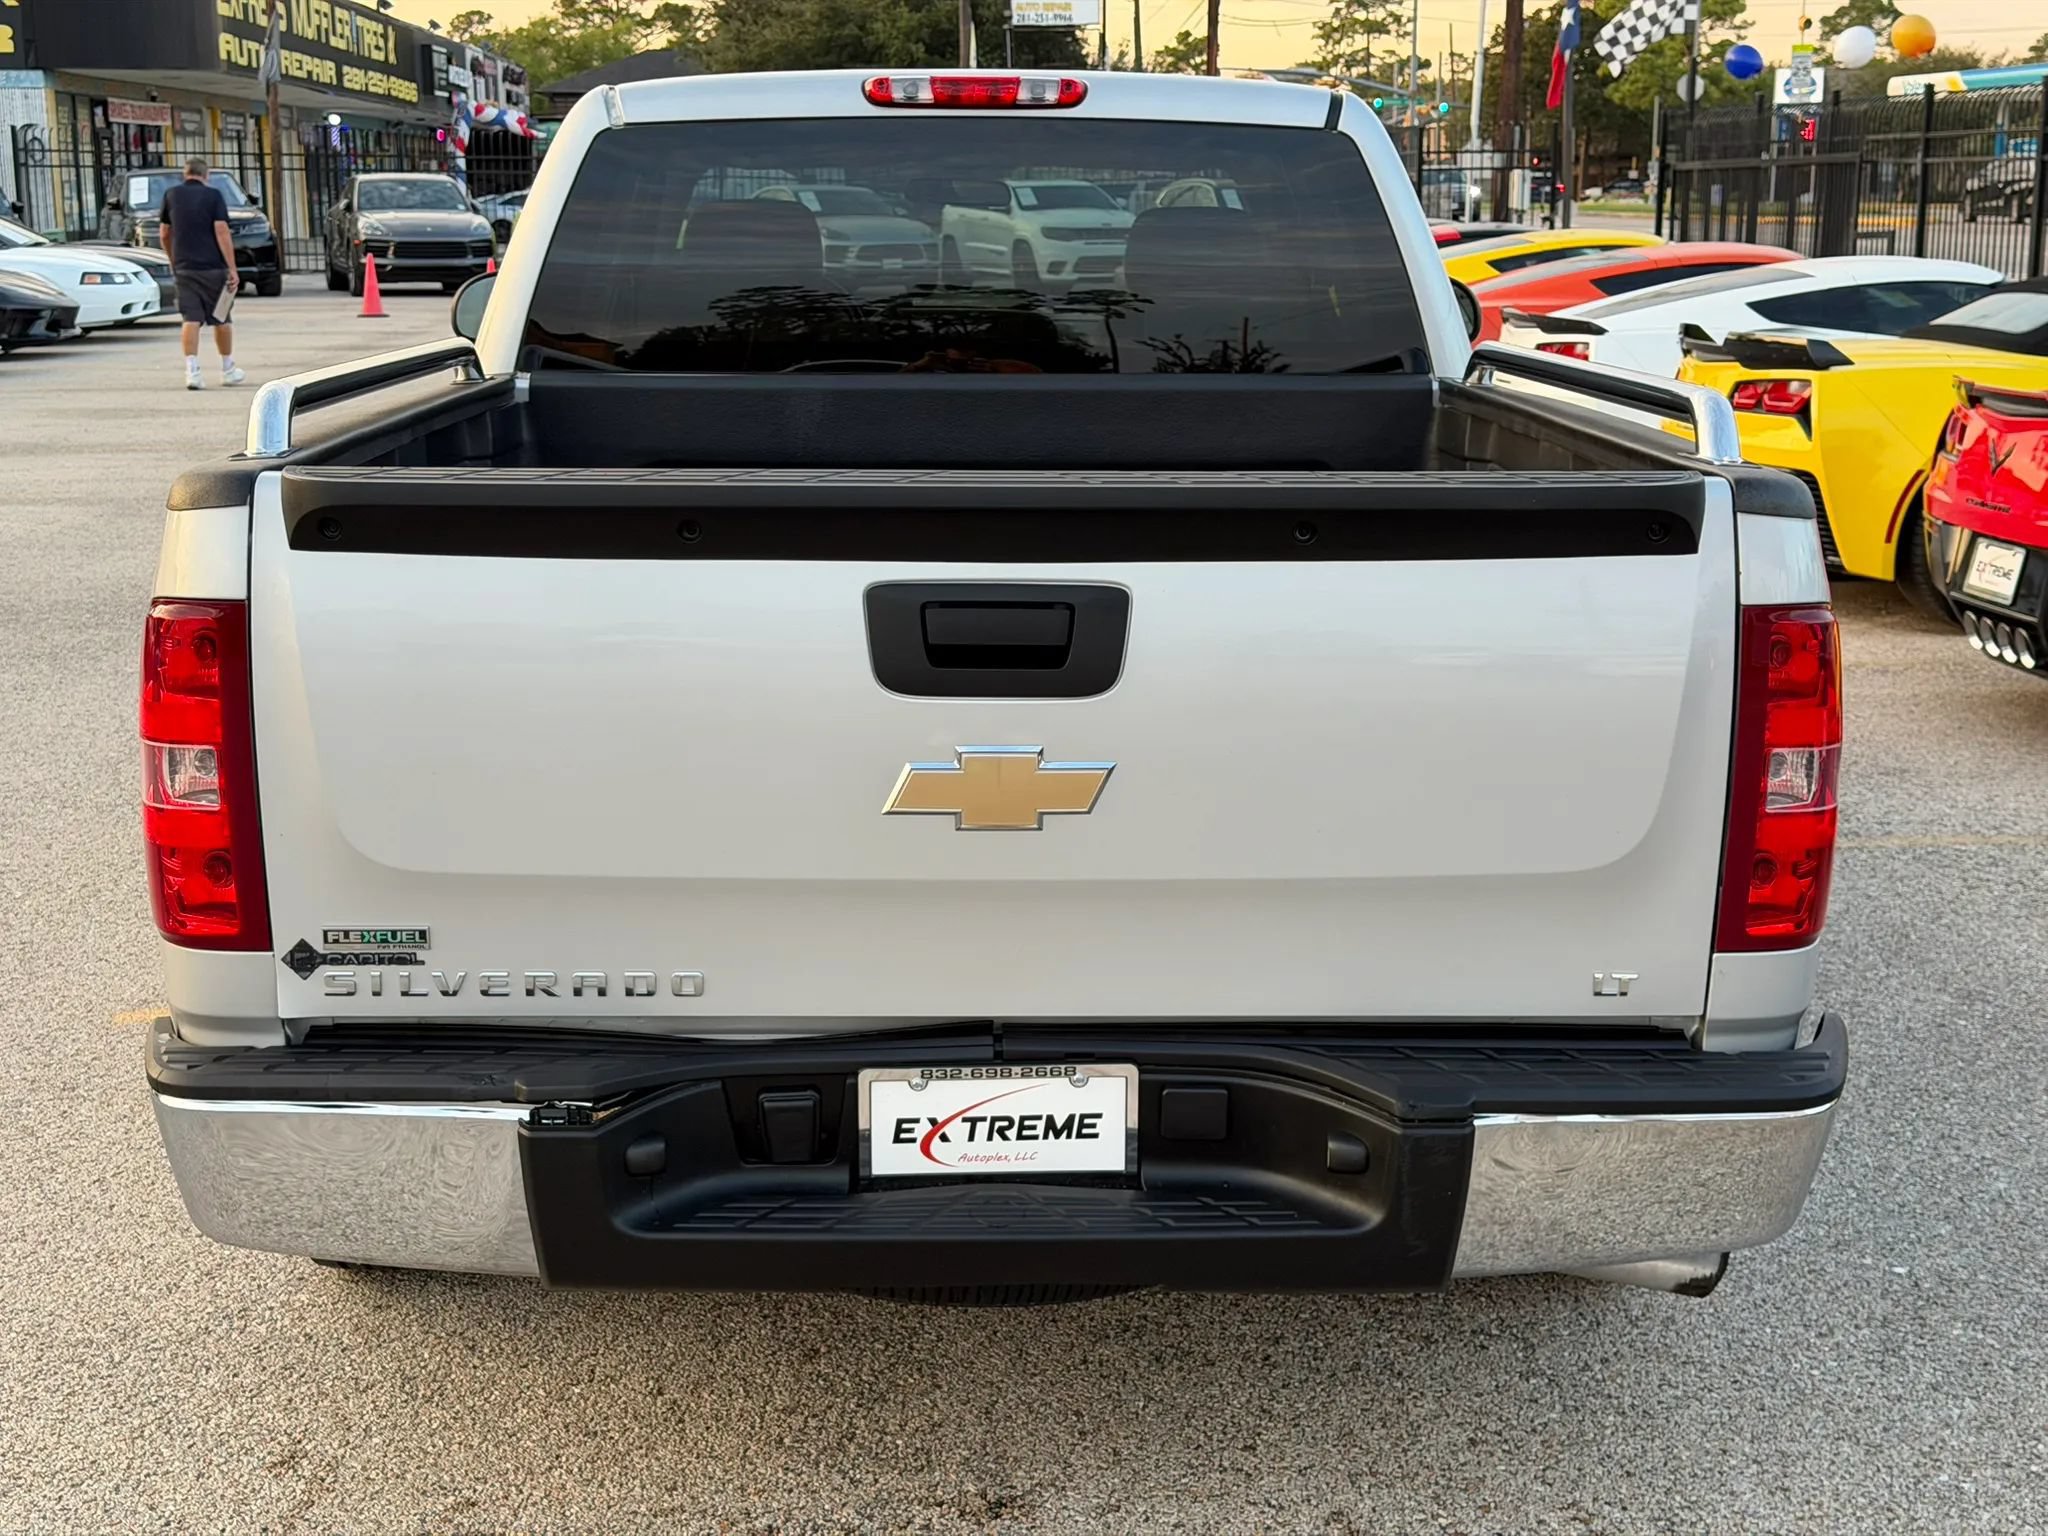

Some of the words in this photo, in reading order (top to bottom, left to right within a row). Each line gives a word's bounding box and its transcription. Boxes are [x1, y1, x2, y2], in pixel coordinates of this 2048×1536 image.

[280, 49, 338, 85] REPAIR
[326, 930, 427, 943] FLEXFUEL
[325, 952, 425, 966] CAPITOL
[322, 969, 705, 998] SILVERADO
[1592, 972, 1640, 997] LT
[919, 1066, 1078, 1080] 832-698-2668
[892, 1112, 1103, 1145] EXTREME
[957, 1151, 1011, 1164] Autoplex,
[1014, 1151, 1039, 1161] LLC
